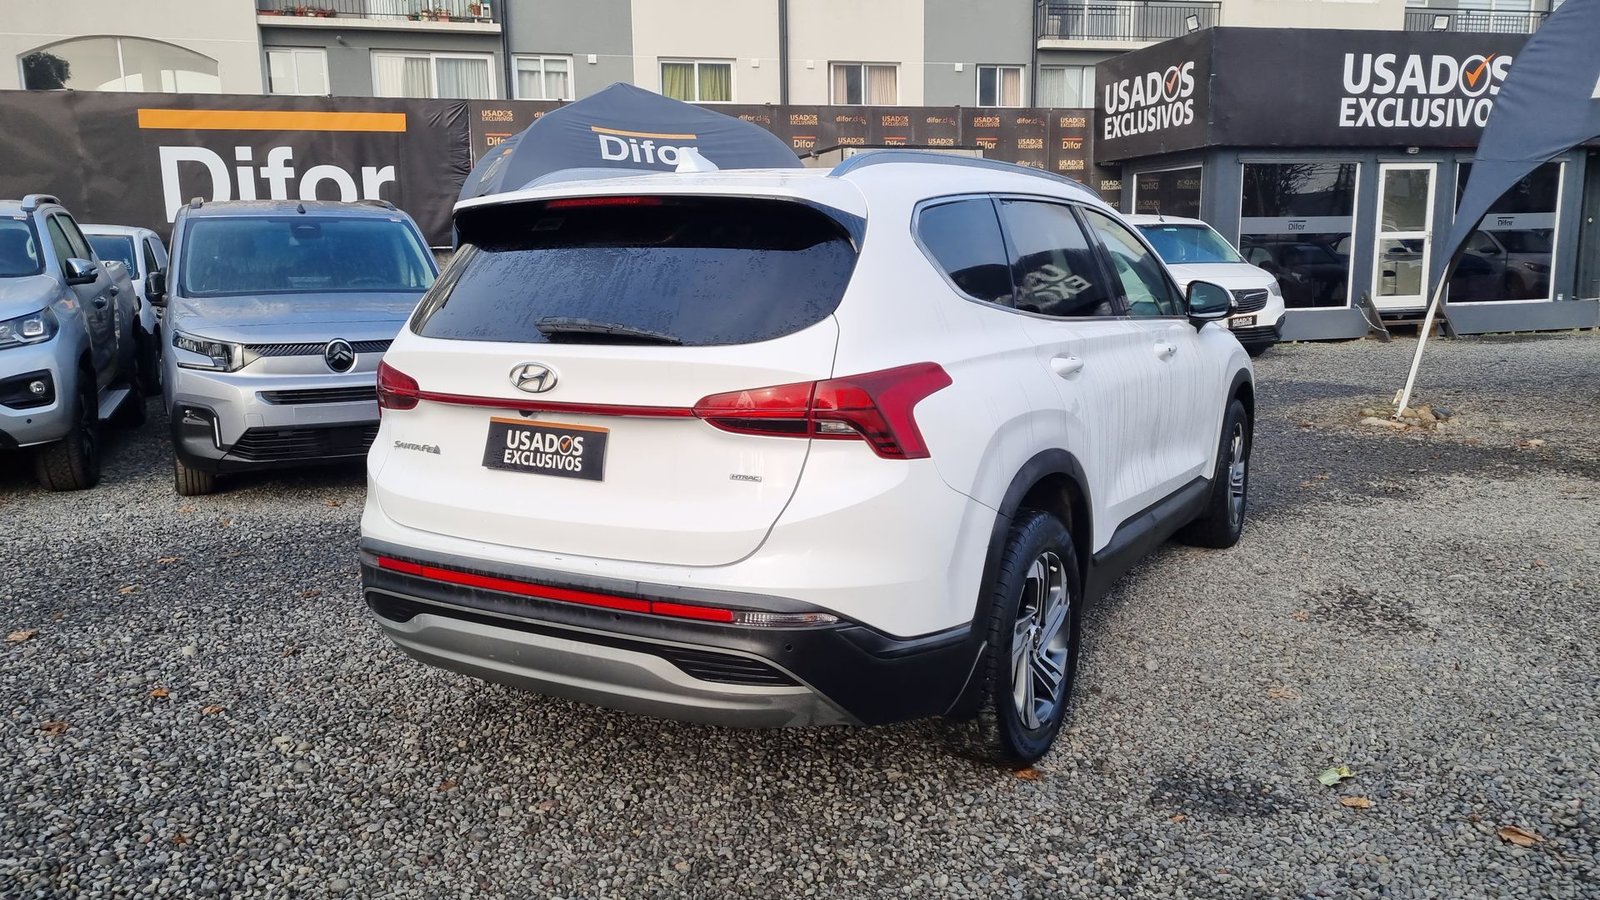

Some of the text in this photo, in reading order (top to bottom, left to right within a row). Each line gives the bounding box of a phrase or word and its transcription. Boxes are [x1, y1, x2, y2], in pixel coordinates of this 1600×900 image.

[1105, 61, 1195, 115] USADOS
[1343, 53, 1512, 97] USADOS
[1104, 98, 1194, 140] EXCLUSIVOS
[1339, 97, 1493, 127] EXCLUSIVO
[793, 139, 815, 148] Difor
[1062, 141, 1082, 149] Difor
[159, 146, 396, 223] Difor
[1288, 223, 1305, 231] Difor
[506, 429, 584, 456] USADOS
[503, 449, 582, 472] EXCLUSIVOS
